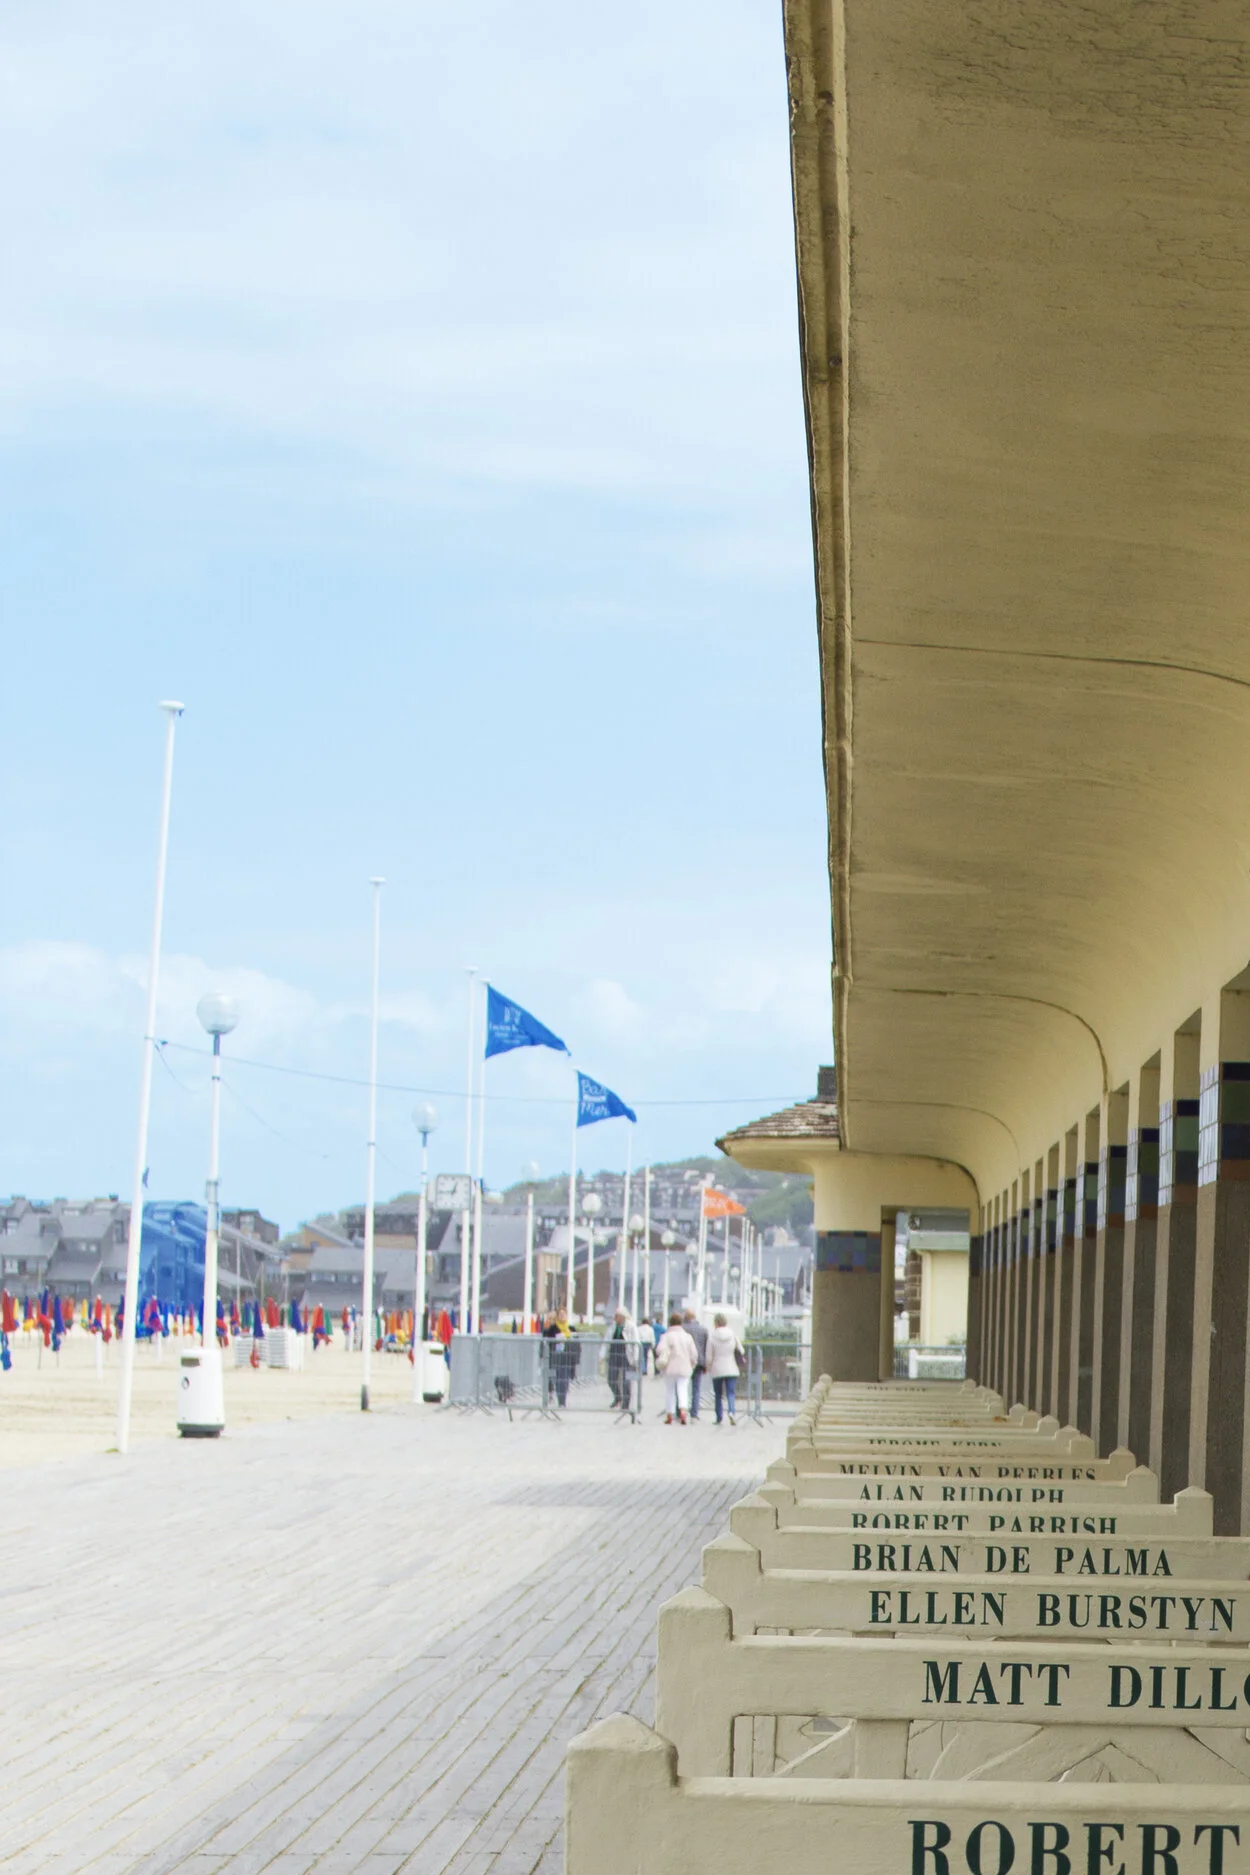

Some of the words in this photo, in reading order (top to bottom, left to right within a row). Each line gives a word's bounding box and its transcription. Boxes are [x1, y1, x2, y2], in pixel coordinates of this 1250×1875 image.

[937, 1465, 983, 1478] VAN
[859, 1483, 925, 1501] ALAN
[941, 1485, 1065, 1503] RUDOLPH
[851, 1513, 969, 1531] ROBERT
[988, 1515, 1118, 1535] PARRISH
[852, 1543, 962, 1573] BRIAN
[984, 1545, 1031, 1574] DE
[1053, 1546, 1174, 1577] PALMA
[868, 1590, 1009, 1627] ELLEN
[1034, 1593, 1238, 1633] BURSTYN
[921, 1660, 1071, 1711] MATT
